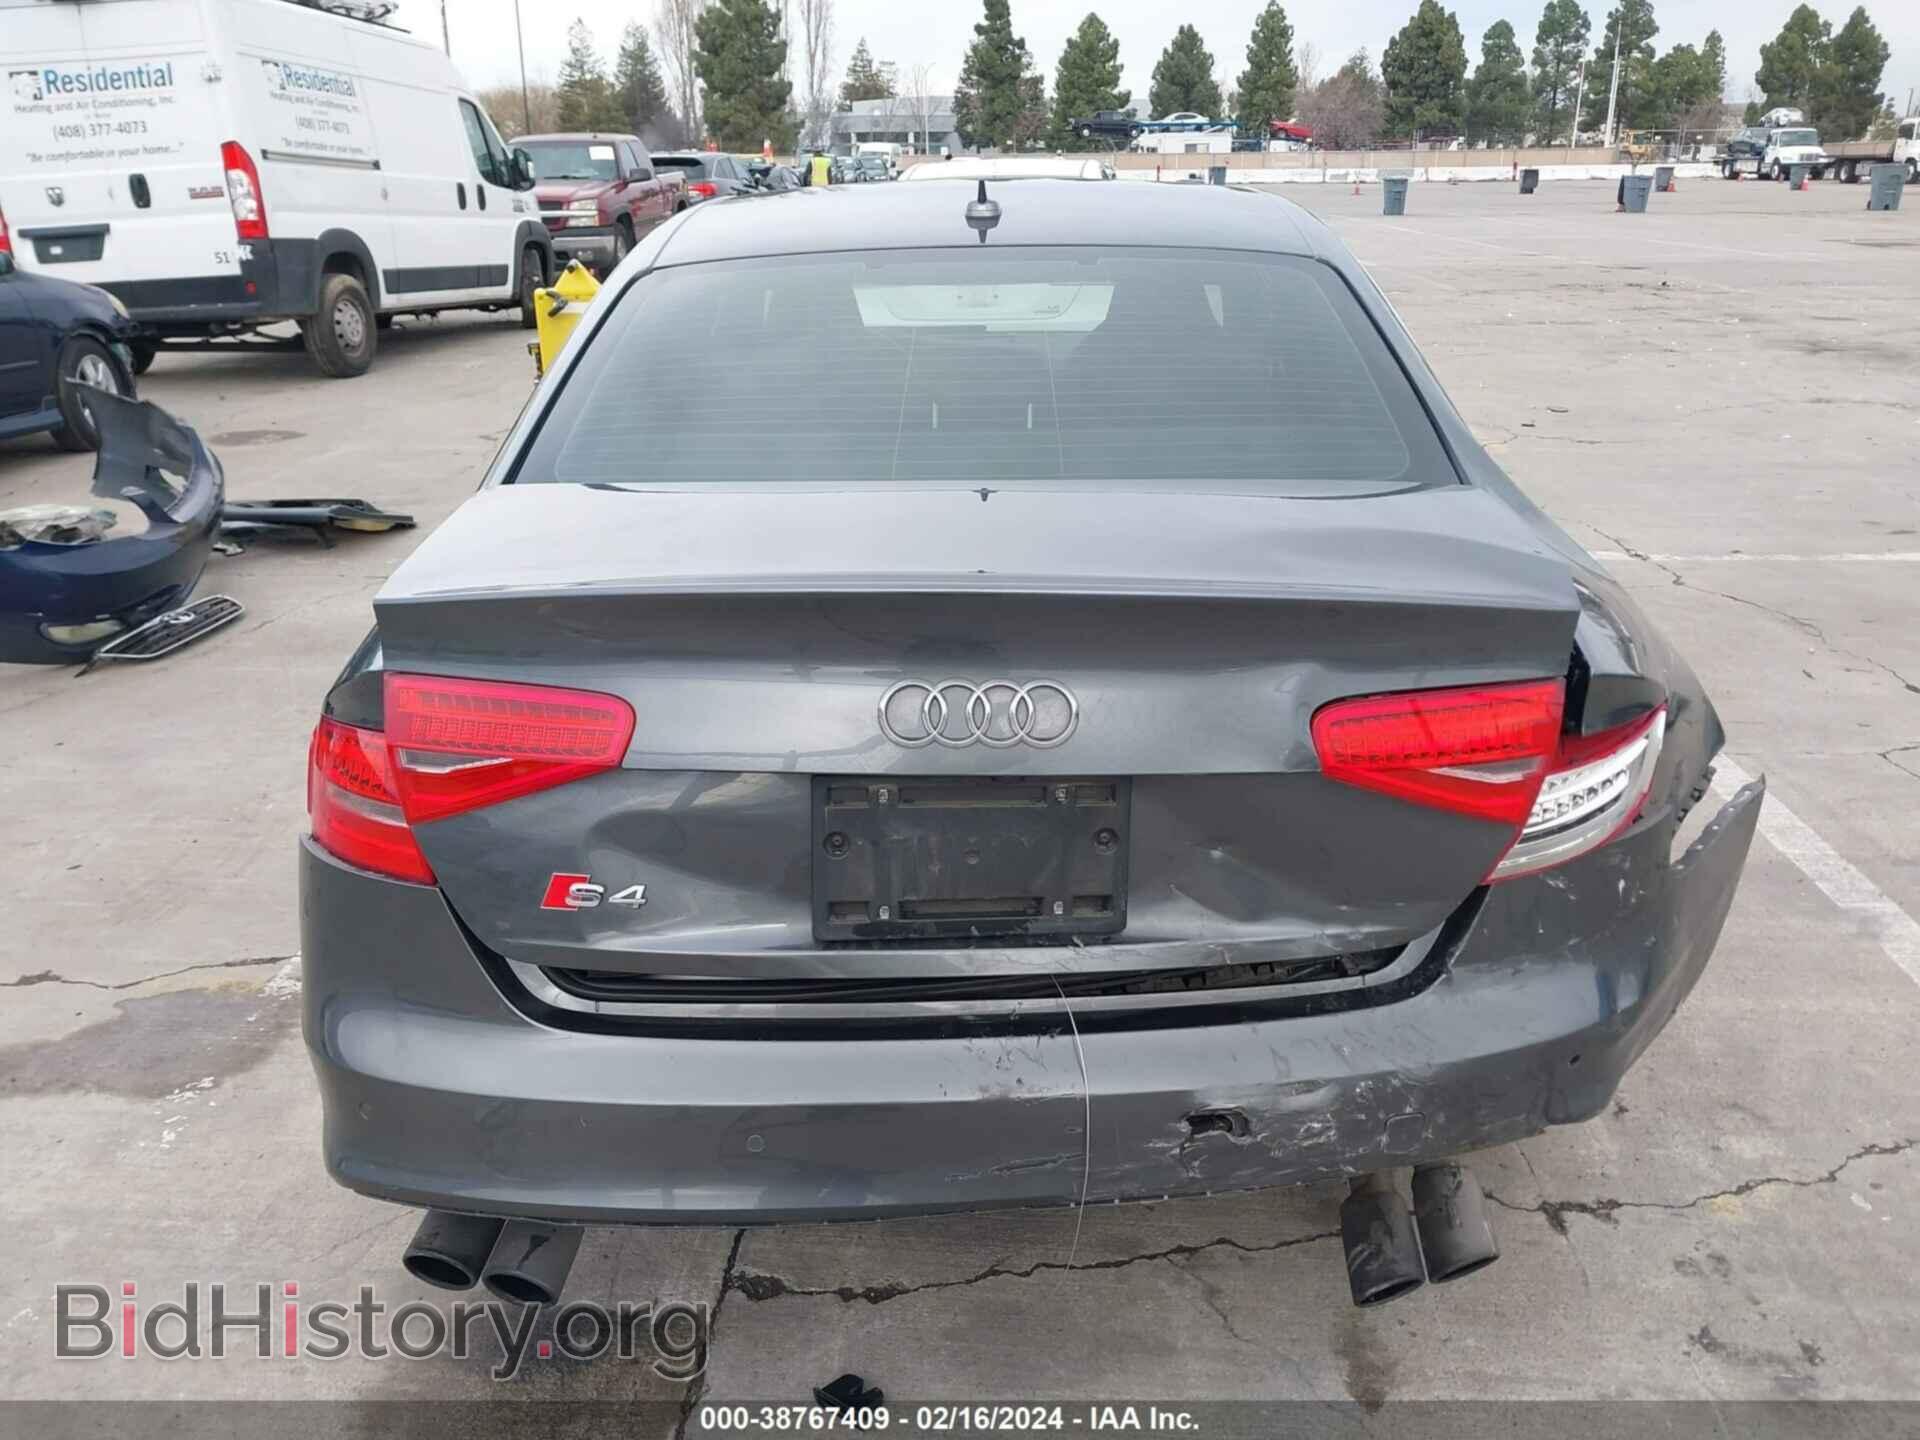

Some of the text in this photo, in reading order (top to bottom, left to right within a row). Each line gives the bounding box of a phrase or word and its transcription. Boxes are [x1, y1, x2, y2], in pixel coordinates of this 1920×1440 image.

[45, 62, 174, 95] Residential
[53, 120, 148, 142] (408) 377-4073
